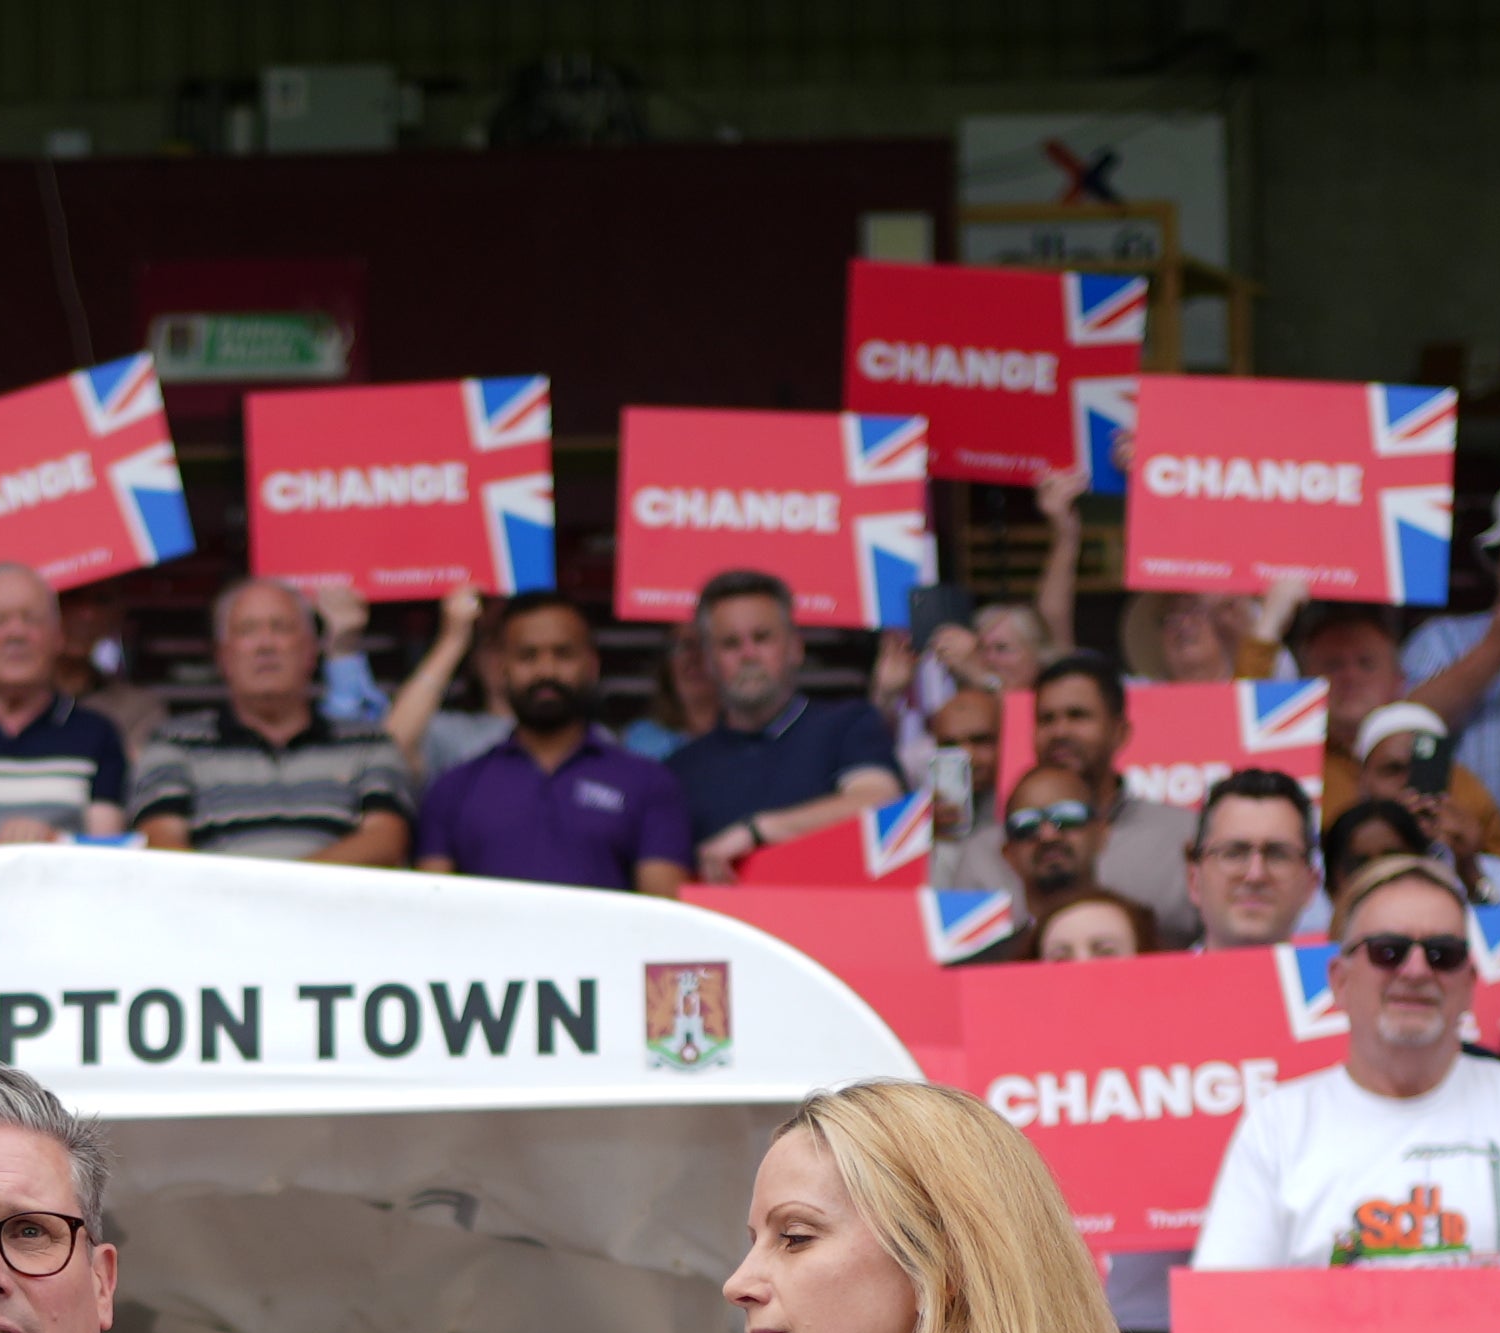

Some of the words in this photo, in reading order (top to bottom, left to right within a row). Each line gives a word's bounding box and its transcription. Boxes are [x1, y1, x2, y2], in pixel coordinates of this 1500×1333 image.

[858, 341, 1058, 393] CHANGE
[262, 462, 468, 512] CHANGE
[1144, 456, 1362, 504] CHANGE
[633, 487, 839, 532] CHANGE
[298, 978, 598, 1059] TOWN
